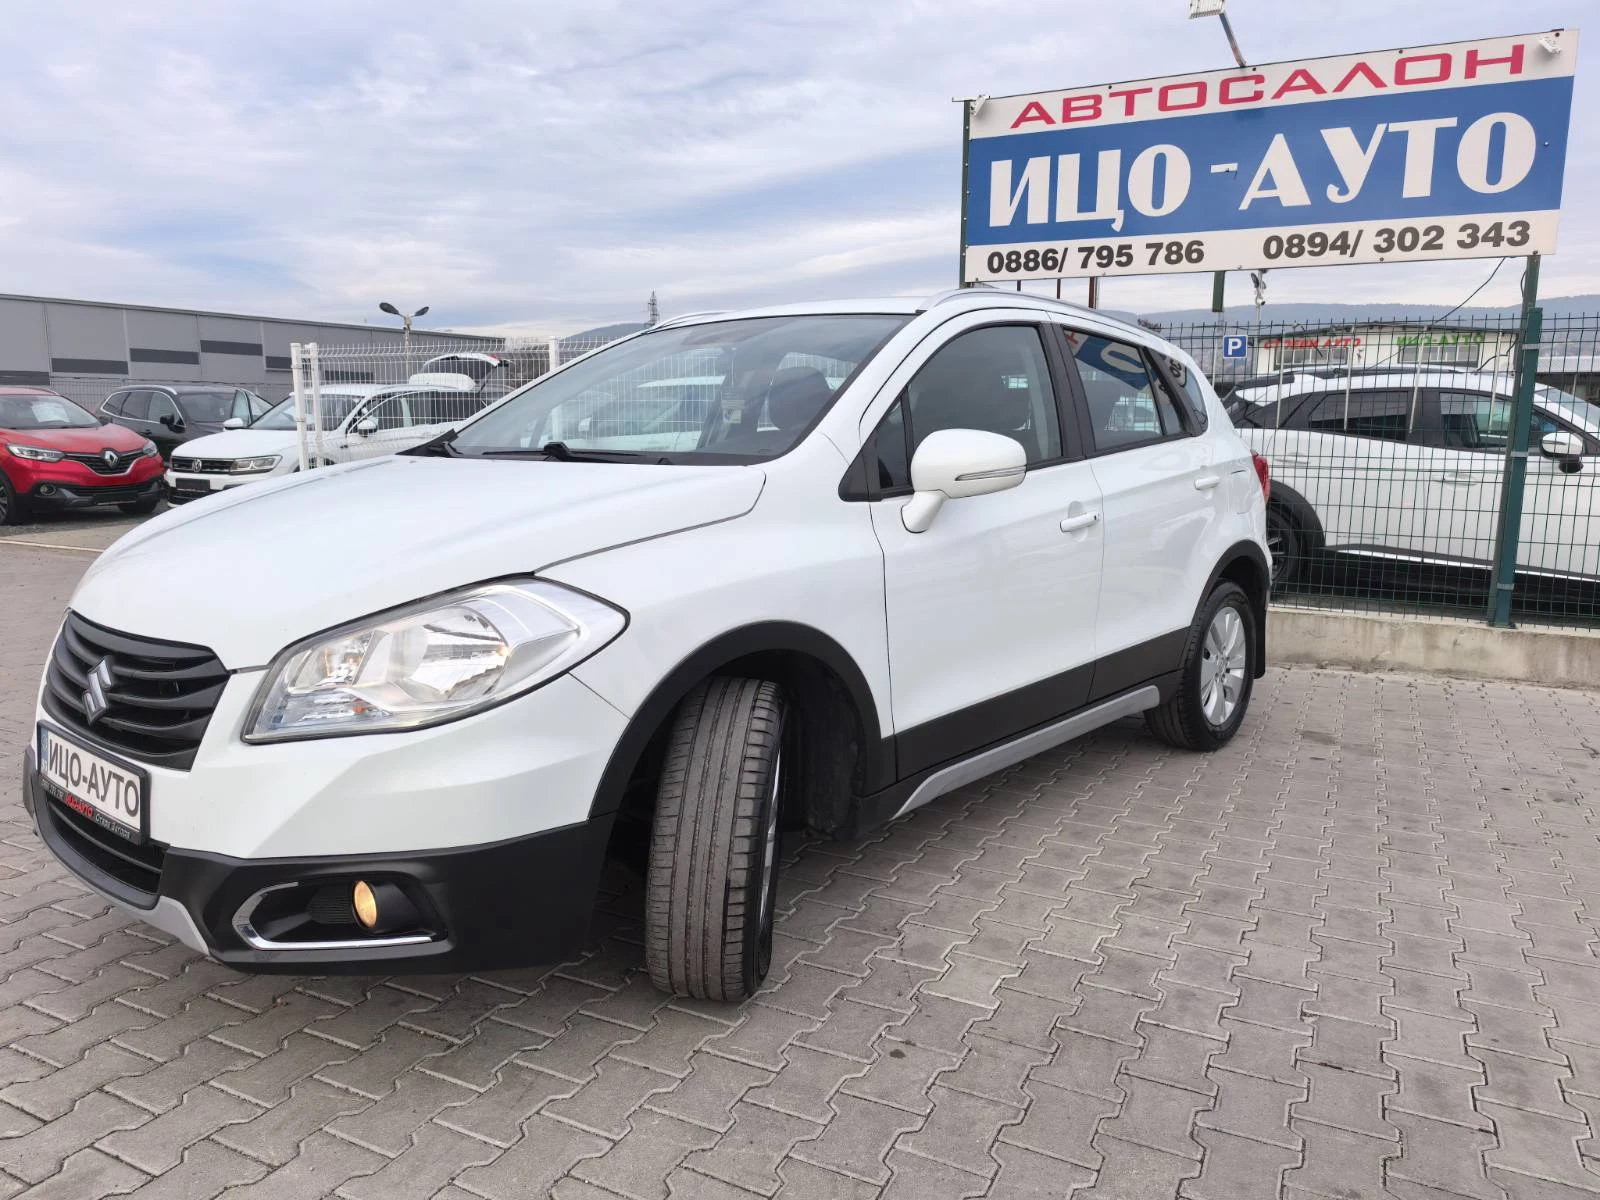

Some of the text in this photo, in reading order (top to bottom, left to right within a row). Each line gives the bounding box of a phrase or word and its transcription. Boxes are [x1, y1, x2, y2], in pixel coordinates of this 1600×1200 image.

[1010, 44, 1525, 129] АВТОСАЛОН
[986, 220, 1531, 275] 0886/ 795 786 0894/ 302 343
[1228, 337, 1242, 355] P
[49, 738, 140, 818] ИЦО-АУТО
